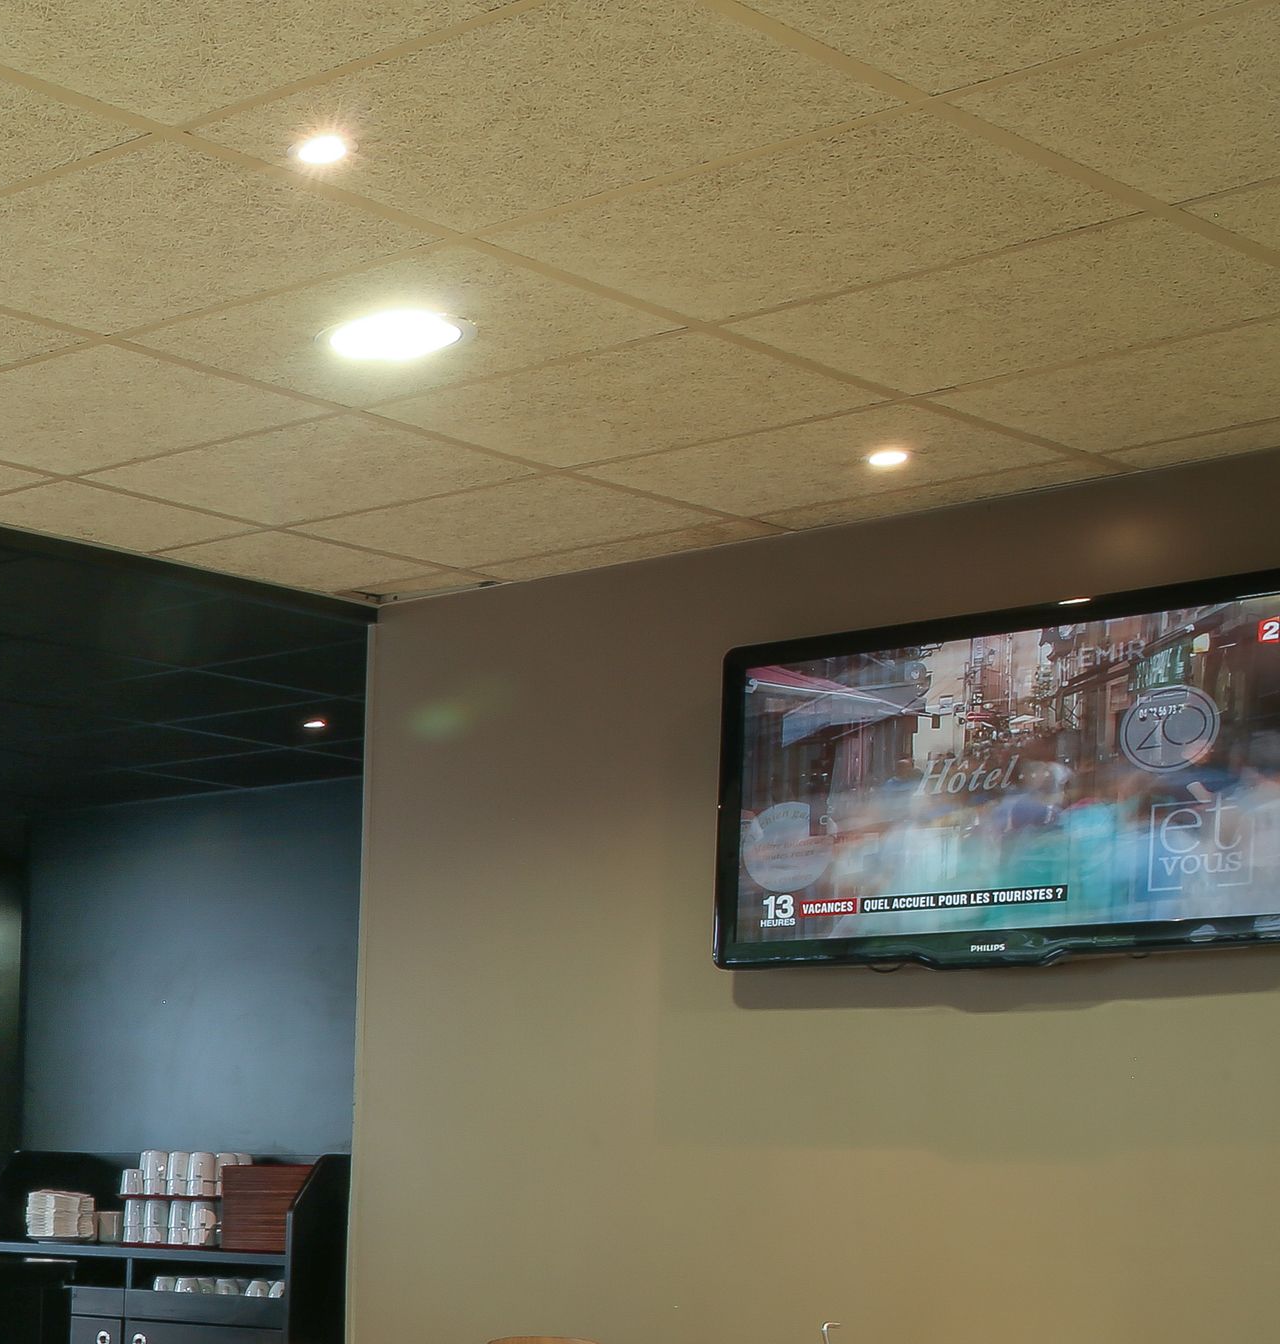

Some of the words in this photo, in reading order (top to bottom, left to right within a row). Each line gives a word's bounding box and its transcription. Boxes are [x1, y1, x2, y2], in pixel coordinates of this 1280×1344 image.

[1262, 621, 1280, 640] 2
[913, 754, 1019, 796] Hôtel
[1159, 851, 1243, 876] vous
[763, 895, 794, 918] 13
[803, 901, 854, 915] VACANCES
[864, 899, 890, 912] QUEL
[892, 896, 936, 910] ACCUEIL
[939, 895, 968, 907] POUR
[971, 893, 990, 905] LES
[993, 889, 1053, 903] TOURISTES
[1056, 888, 1063, 898] ?
[760, 918, 796, 928] HEURES
[970, 943, 1006, 953] PHILIPS
